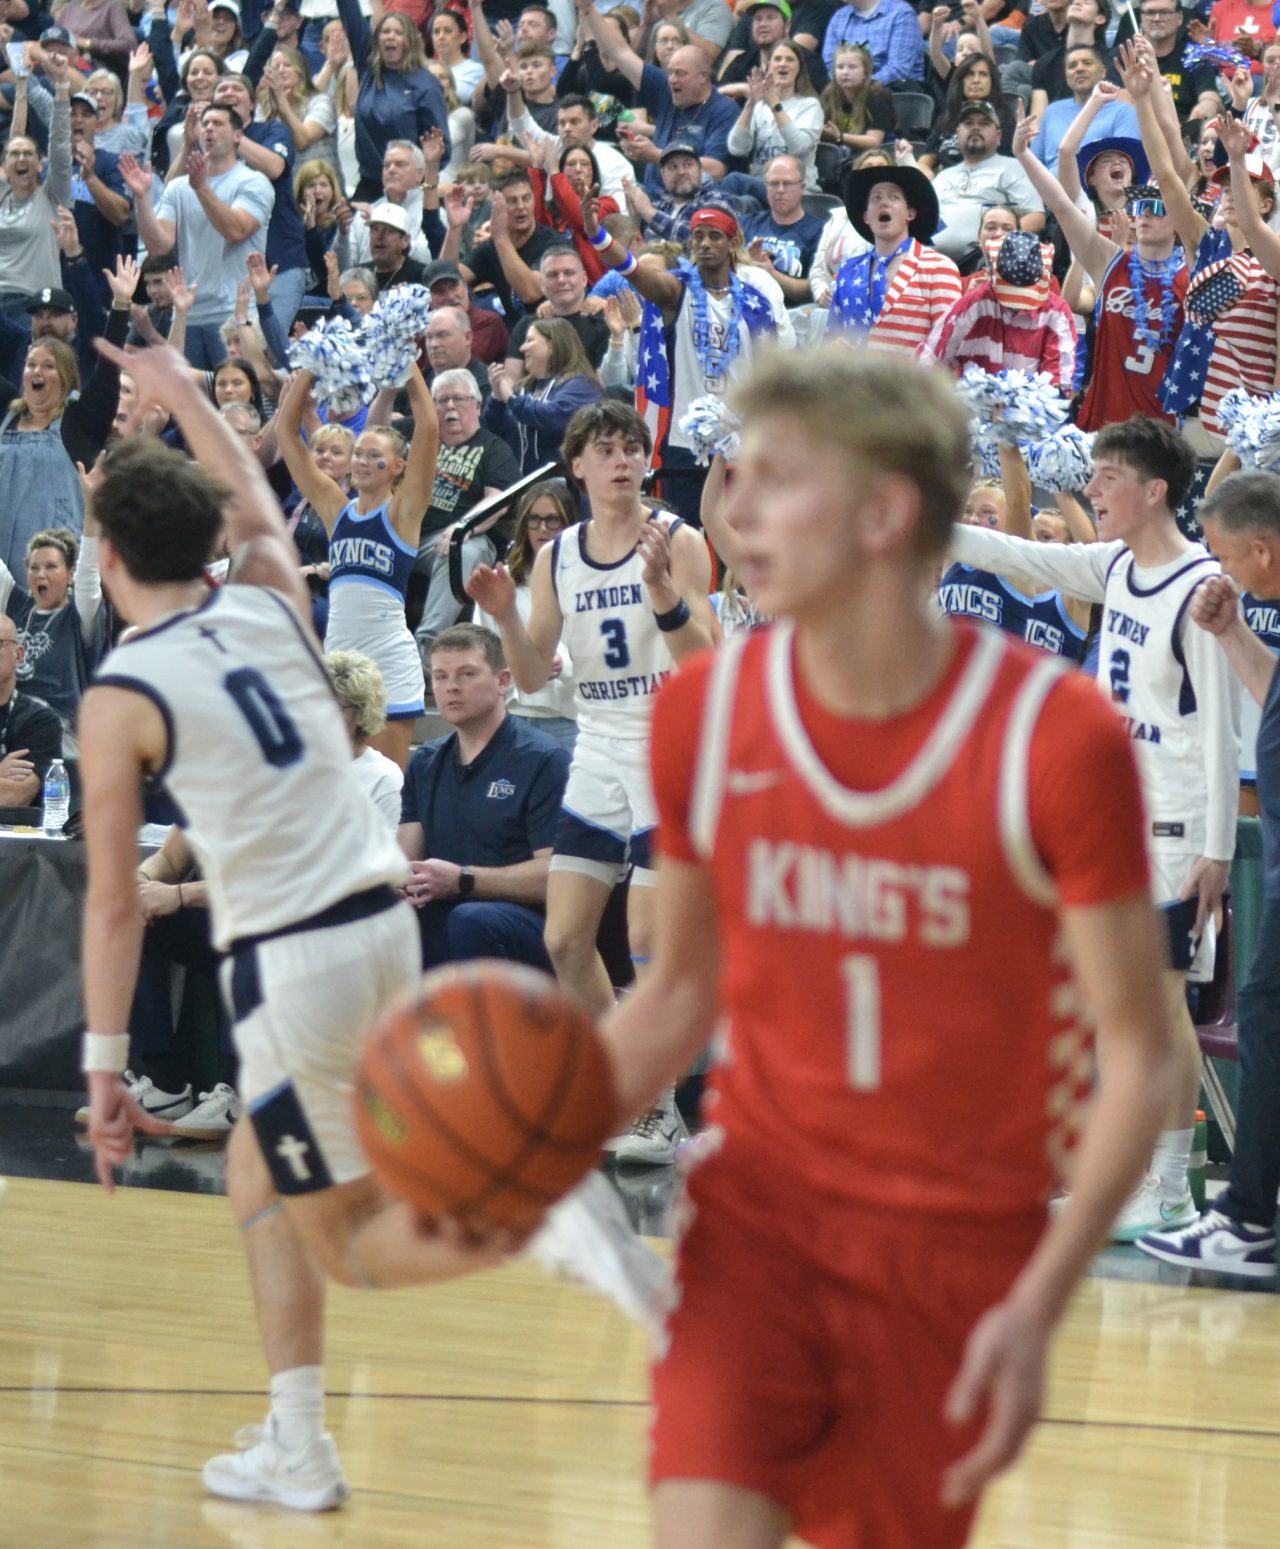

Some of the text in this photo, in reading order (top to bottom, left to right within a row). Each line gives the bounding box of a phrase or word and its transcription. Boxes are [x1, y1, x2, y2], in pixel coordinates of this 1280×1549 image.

[42, 287, 52, 303] S
[1125, 328, 1160, 375] 3
[329, 538, 395, 577] LYNCS
[576, 583, 642, 613] LYNDEN
[939, 583, 1003, 625] YNCS
[600, 617, 630, 669] 3
[224, 667, 304, 767] 0
[841, 953, 882, 1093] 1
